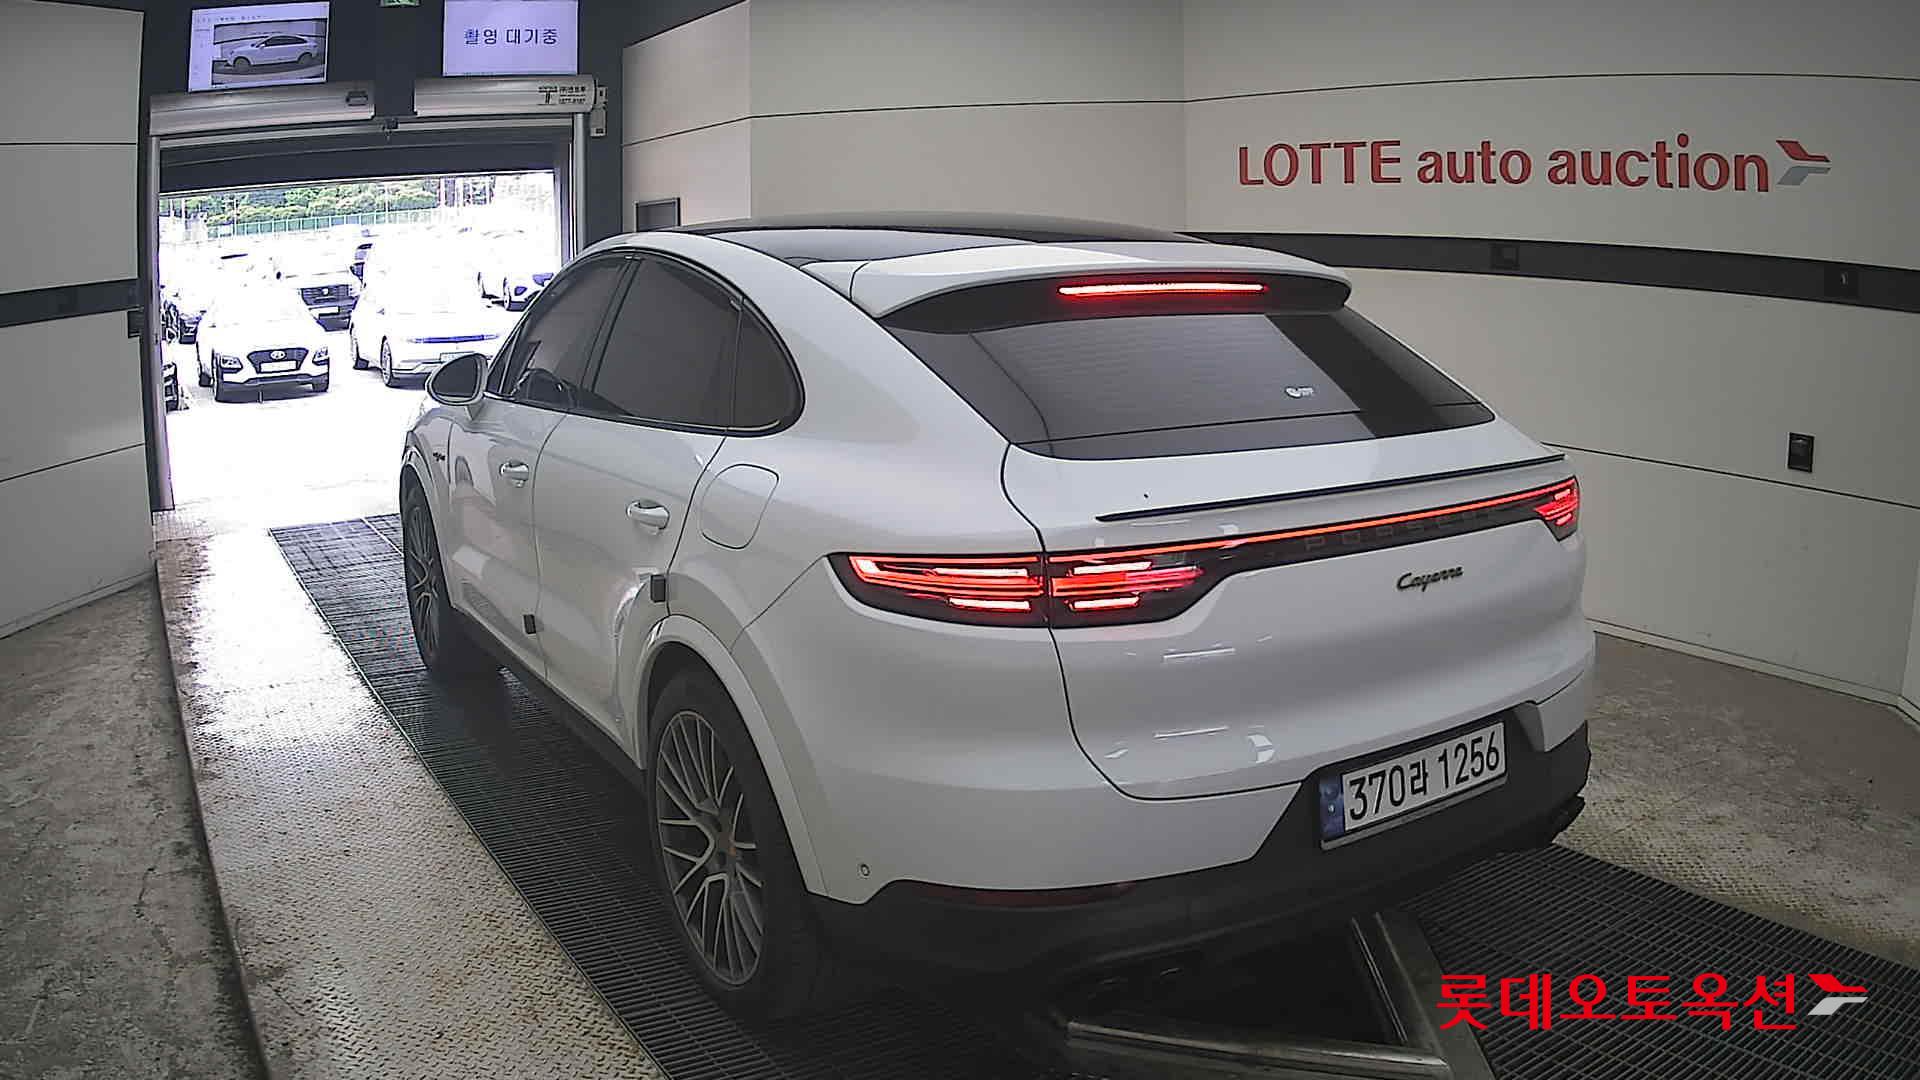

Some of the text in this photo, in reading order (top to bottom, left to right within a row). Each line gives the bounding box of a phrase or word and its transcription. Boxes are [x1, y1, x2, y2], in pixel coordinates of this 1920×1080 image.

[464, 28, 558, 45] 촬영 대기중
[1238, 133, 1769, 192] LOTTE auto auction
[1304, 505, 1510, 551] PORSC
[1397, 566, 1463, 592] Cayenne
[1350, 731, 1500, 820] 370라 1256
